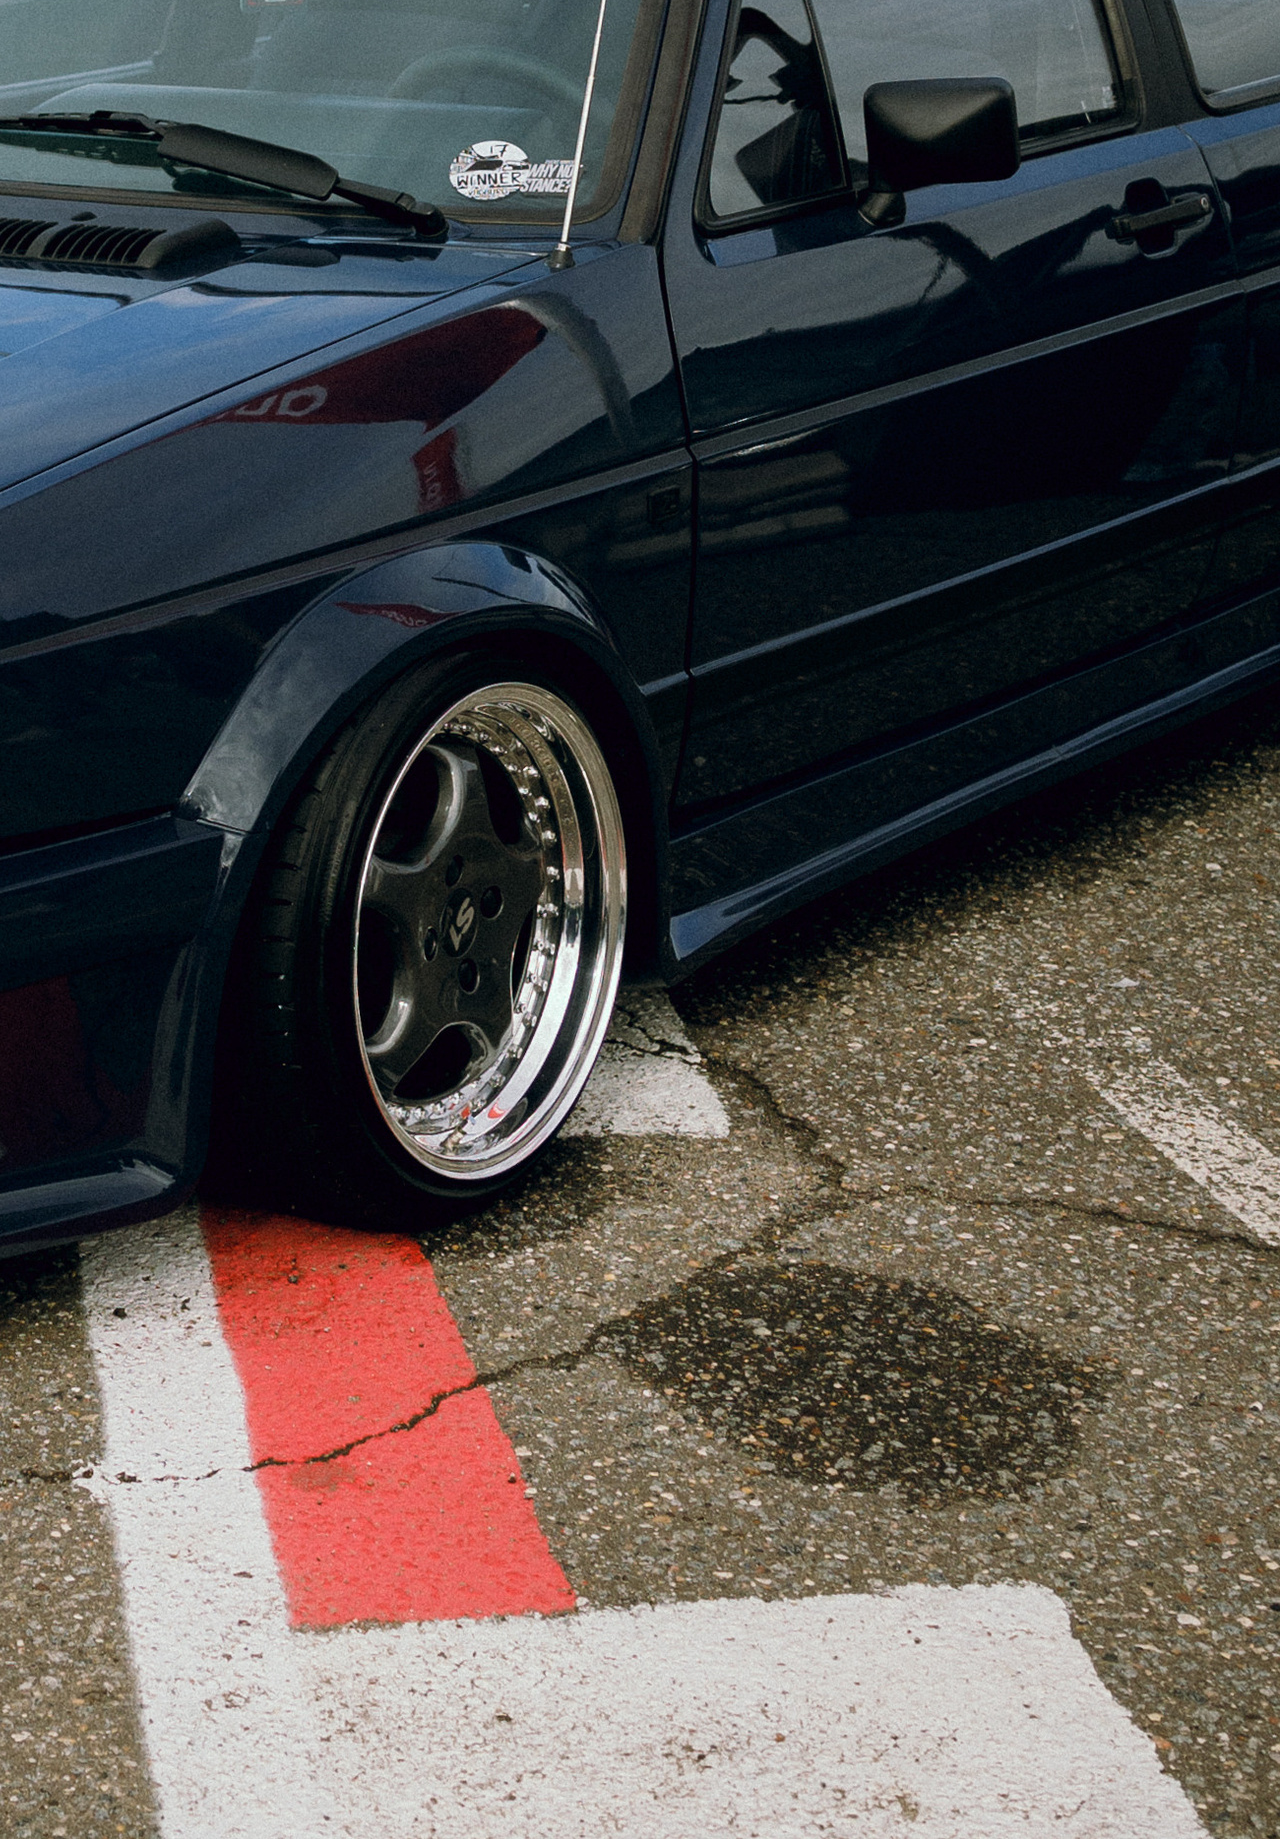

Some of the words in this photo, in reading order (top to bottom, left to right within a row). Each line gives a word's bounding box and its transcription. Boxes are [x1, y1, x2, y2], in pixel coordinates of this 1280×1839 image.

[527, 163, 558, 178] WHY
[556, 164, 579, 178] NO
[457, 172, 522, 187] WINNER
